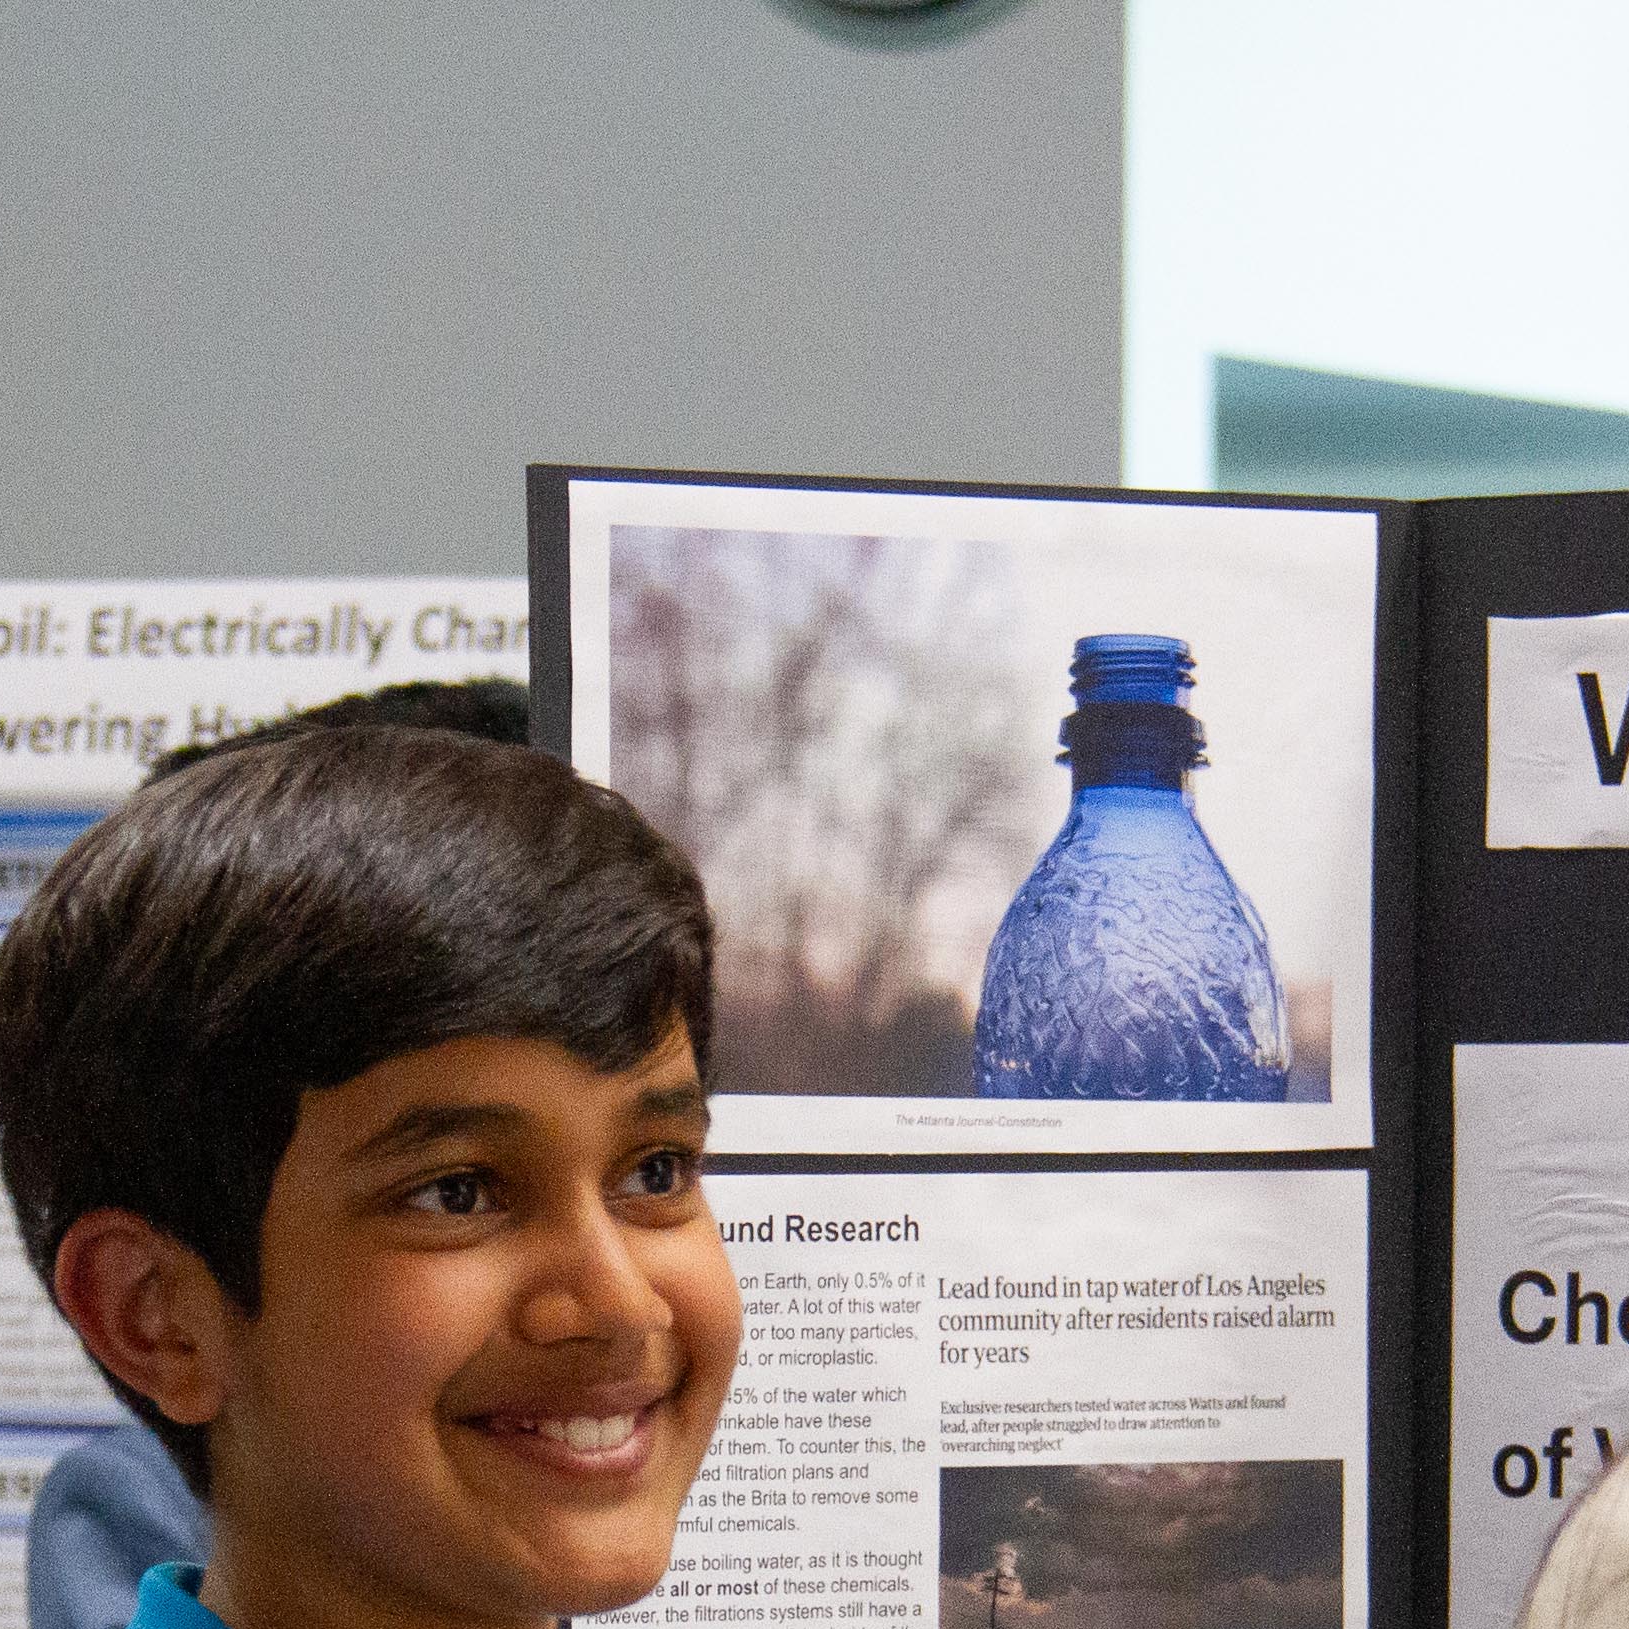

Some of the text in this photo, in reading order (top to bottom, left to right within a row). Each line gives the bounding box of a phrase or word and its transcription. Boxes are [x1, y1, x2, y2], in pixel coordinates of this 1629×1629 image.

[87, 604, 393, 670] Electrically
[896, 1114, 1062, 1128] The Atlanta Journal-Constitution
[785, 1214, 920, 1242] Research
[738, 1271, 925, 1294] on Earth, only 0.5% of it
[938, 1272, 1326, 1304] Lead found in tap water of Los Angeles
[749, 1322, 918, 1345] or too many particles,
[938, 1303, 1335, 1337] community after residents raised alarm
[757, 1352, 774, 1367] or
[778, 1348, 877, 1369] microplastic.
[940, 1339, 1030, 1369] for years
[708, 1436, 927, 1456] of them. To counter this, the
[1491, 1427, 1574, 1499] of
